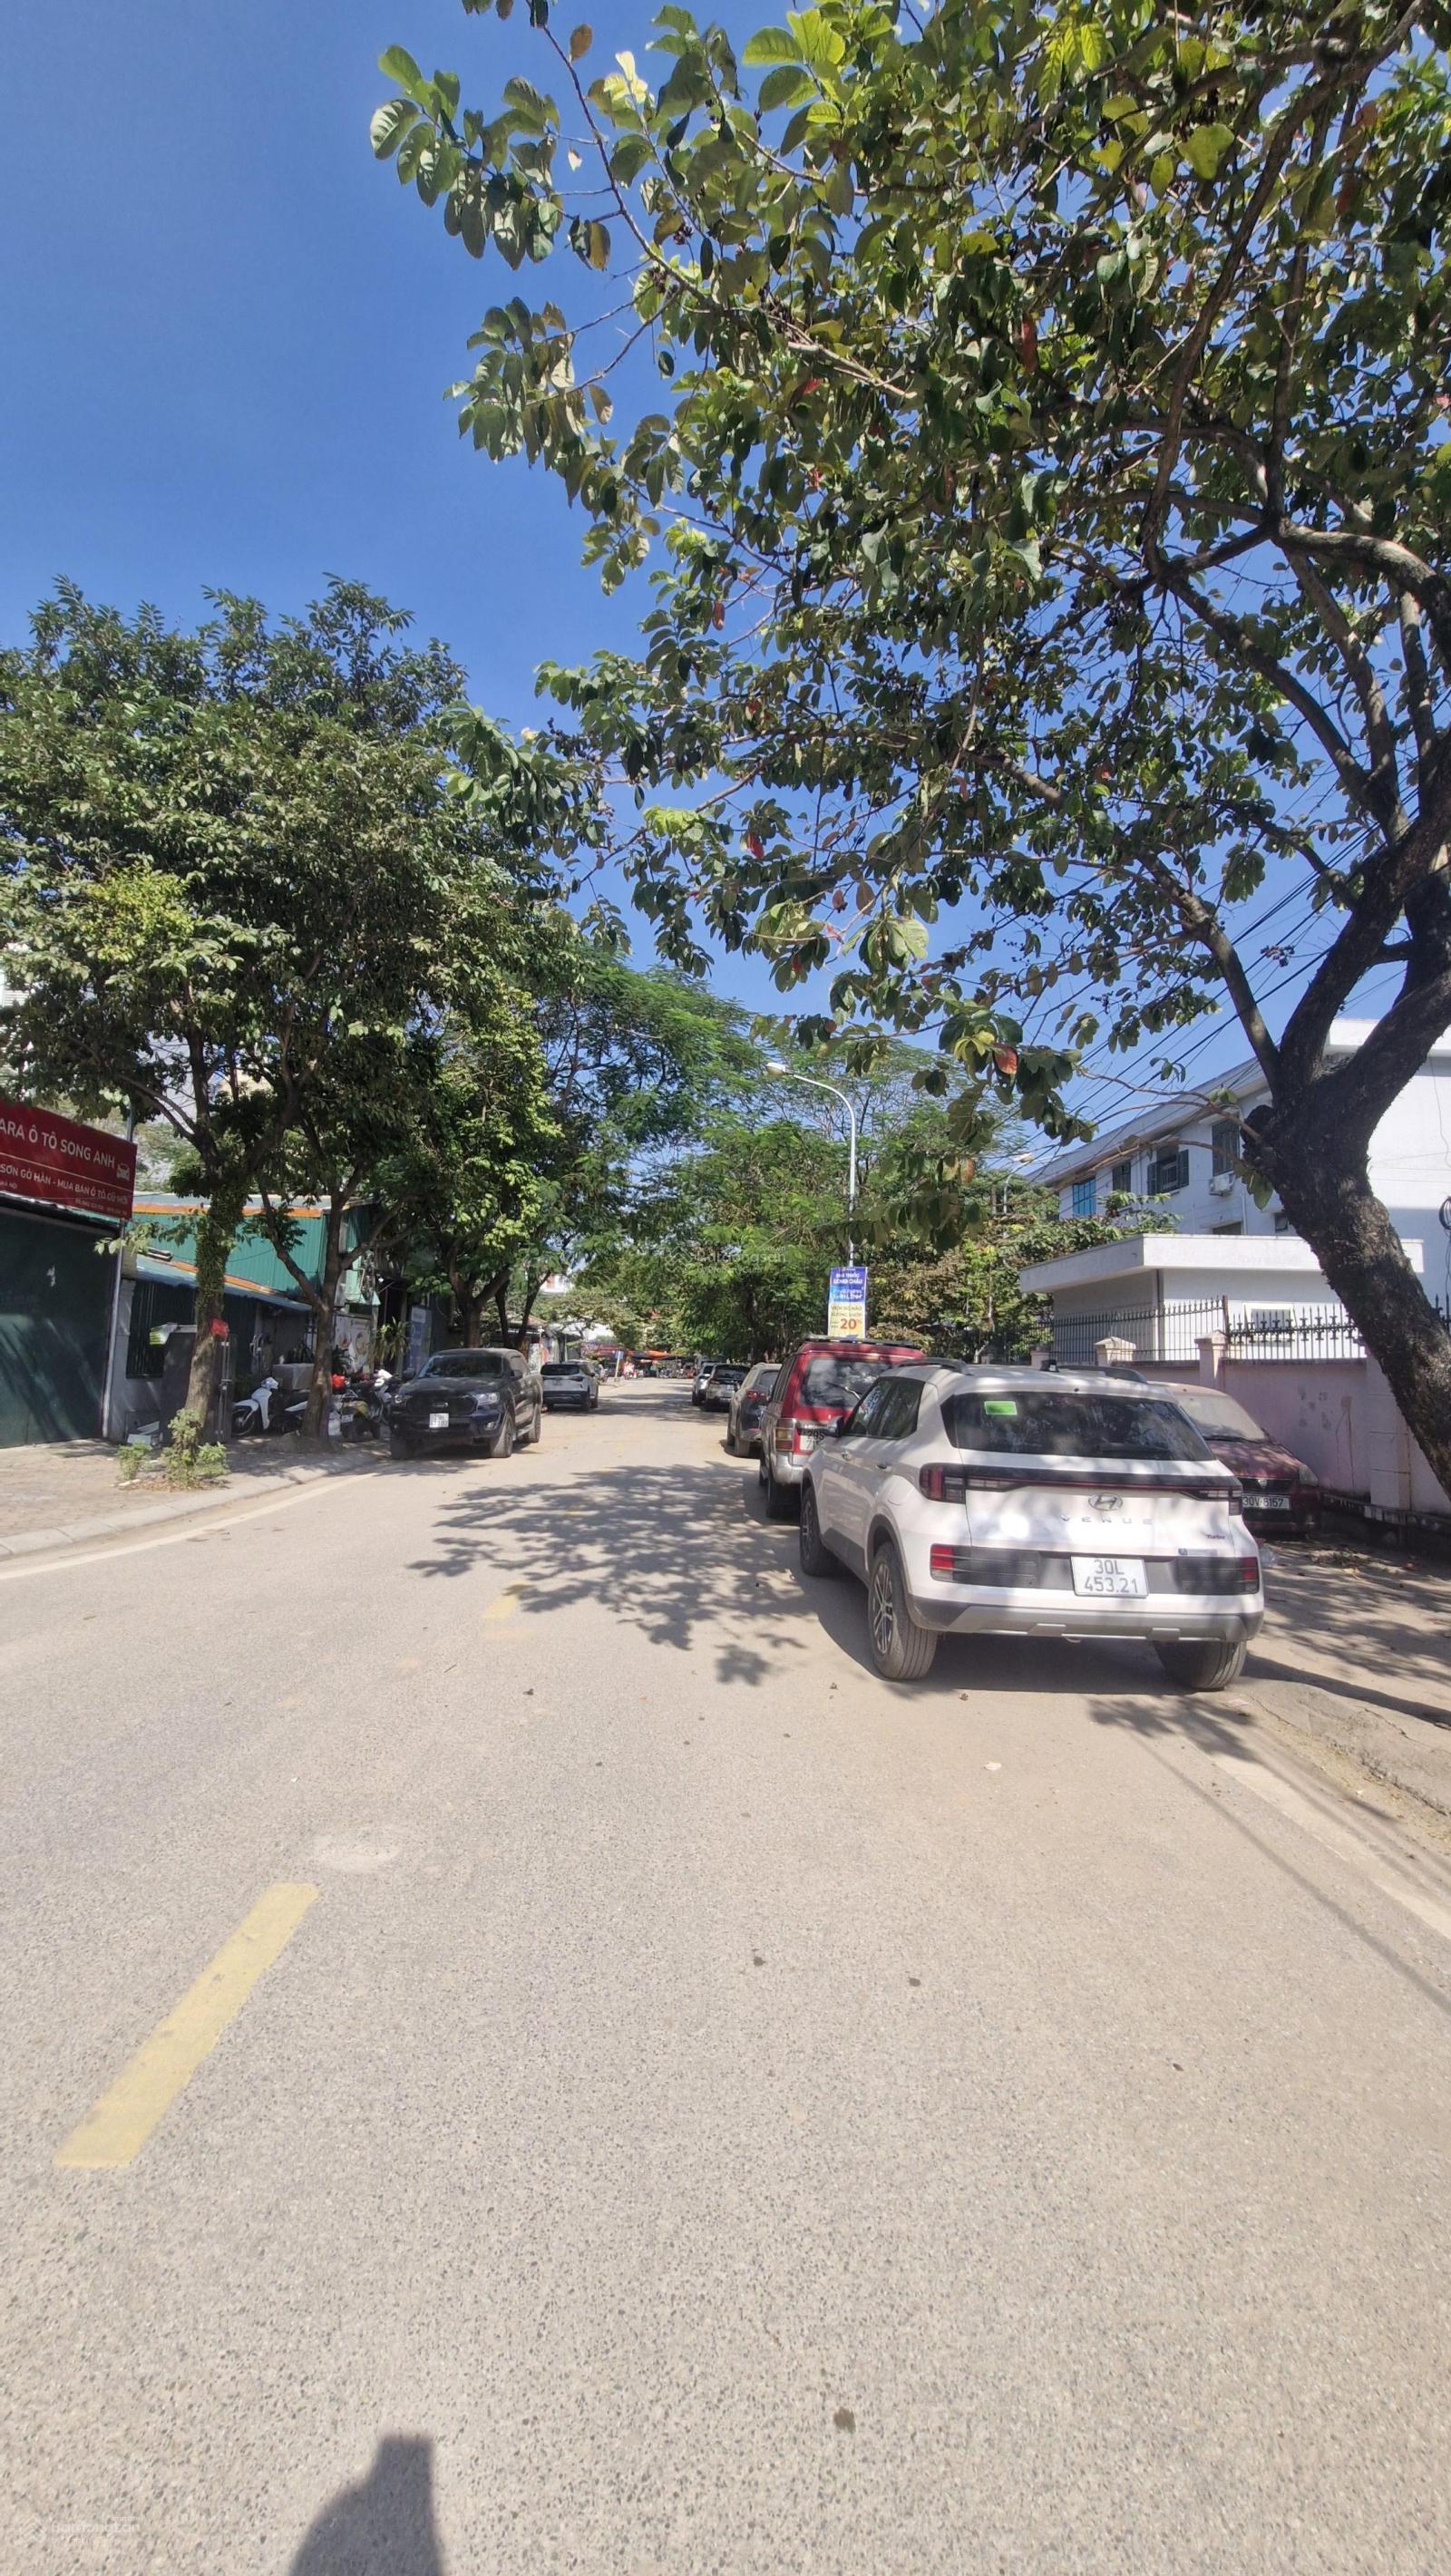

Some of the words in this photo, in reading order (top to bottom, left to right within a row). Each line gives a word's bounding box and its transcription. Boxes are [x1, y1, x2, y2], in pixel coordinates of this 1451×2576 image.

[28, 1123, 38, 1143] Ô
[41, 1131, 57, 1150] TÔ
[60, 1139, 92, 1161] SONG
[93, 1150, 115, 1169] ANH
[1061, 1514, 1154, 1525] VENUE
[1094, 1559, 1125, 1575] 30L
[1084, 1576, 1139, 1594] 453.21
